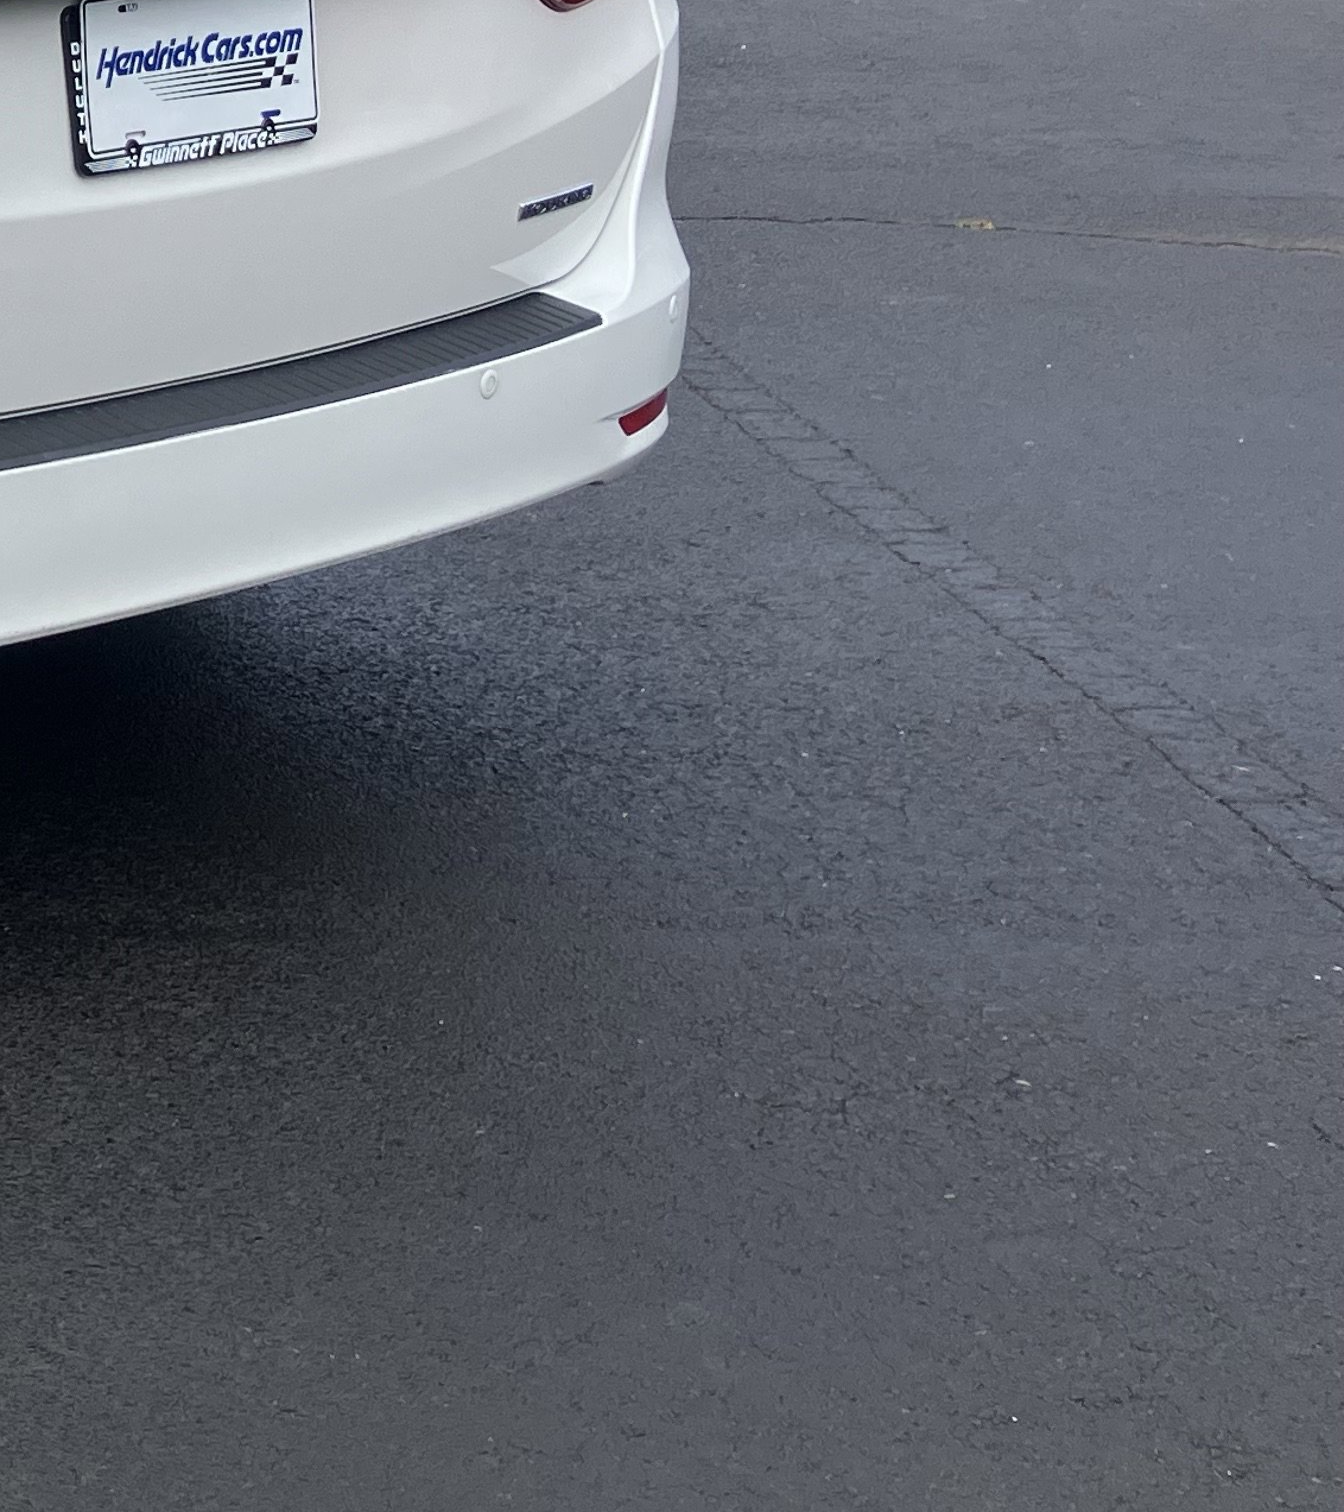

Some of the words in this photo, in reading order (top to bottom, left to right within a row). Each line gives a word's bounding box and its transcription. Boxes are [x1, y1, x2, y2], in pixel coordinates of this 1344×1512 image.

[69, 41, 89, 145] DULUTH
[138, 134, 220, 168] Gwinnett
[219, 130, 268, 156] Place
